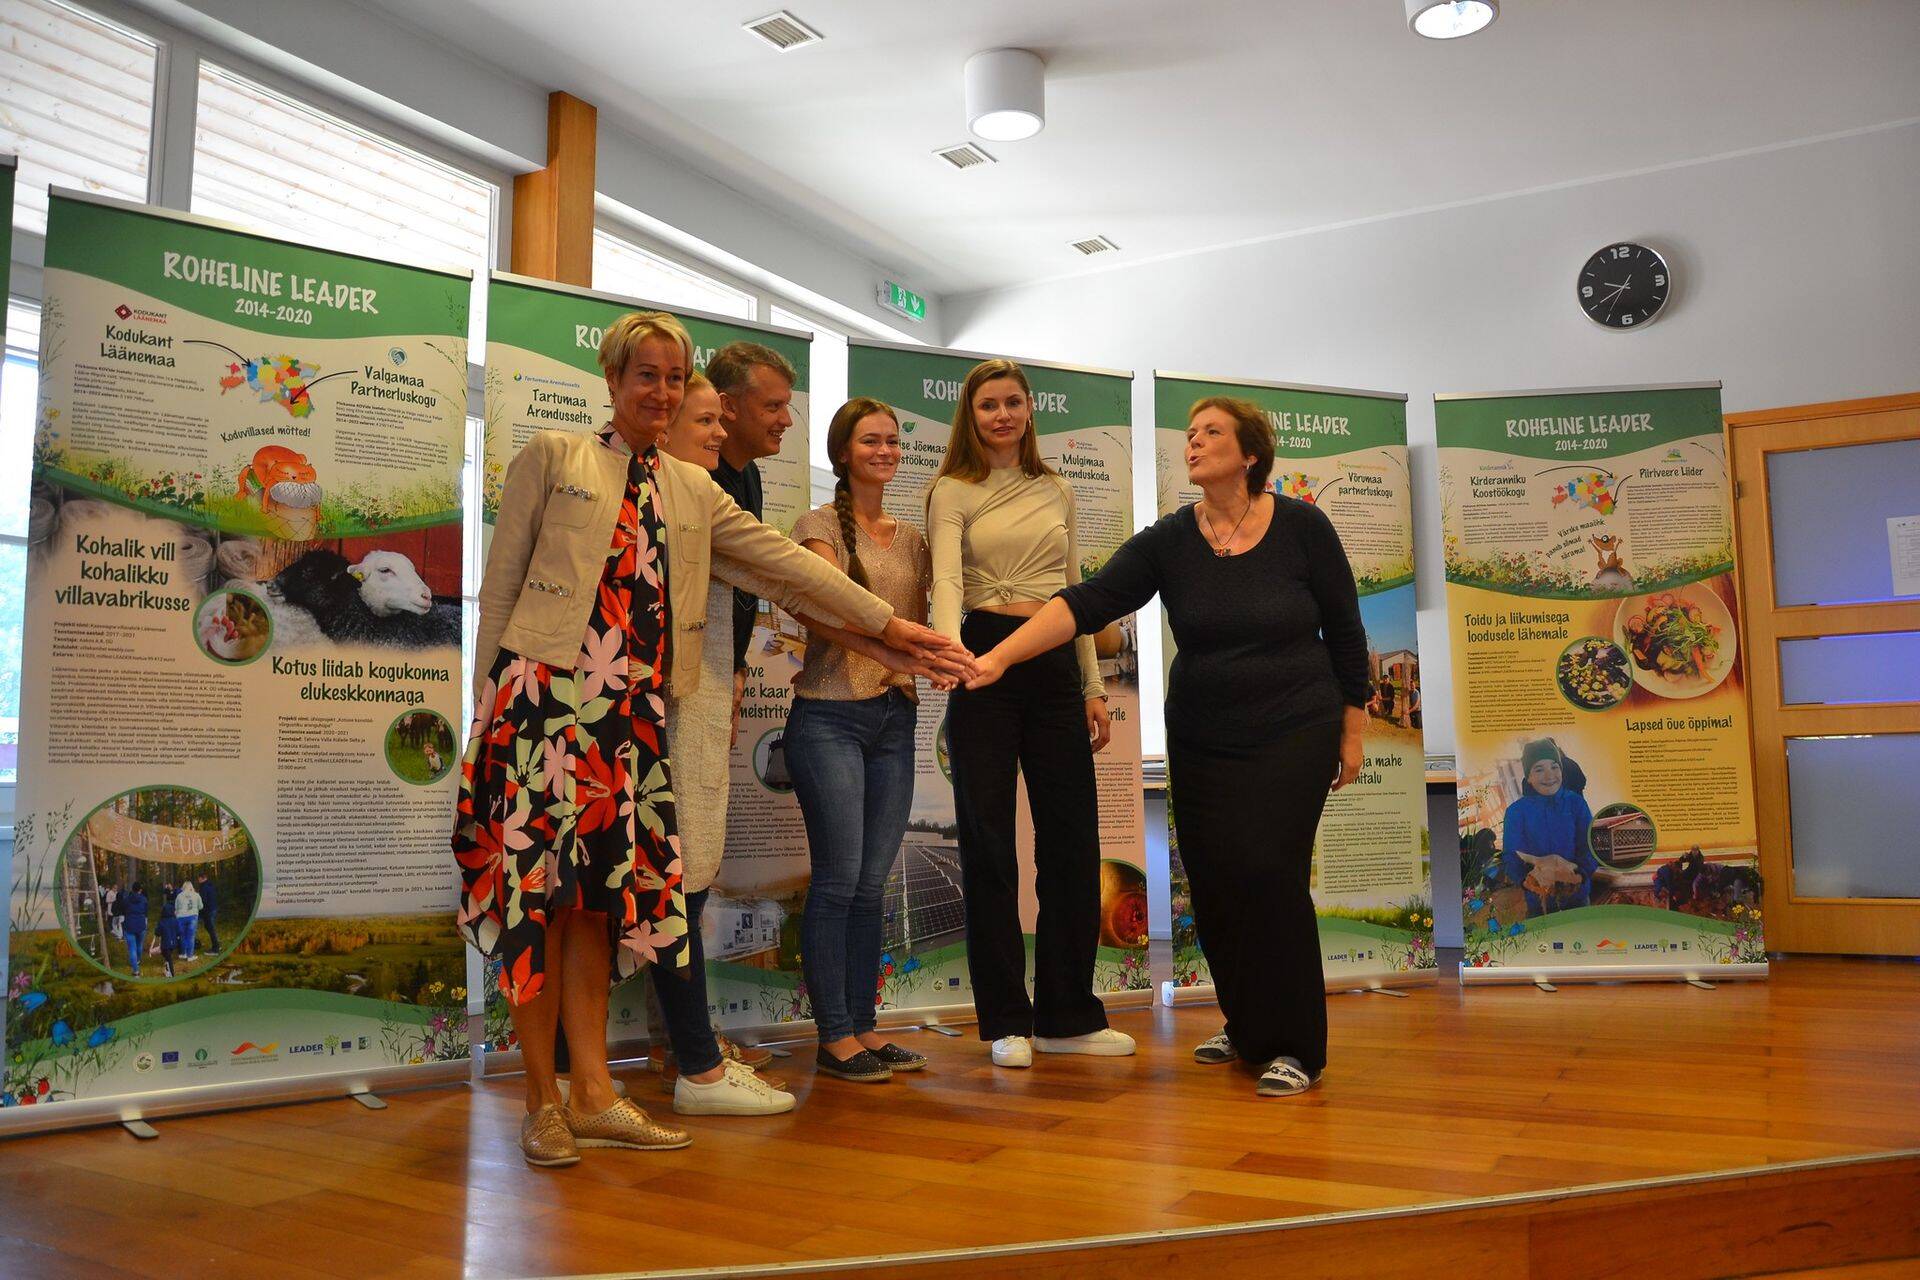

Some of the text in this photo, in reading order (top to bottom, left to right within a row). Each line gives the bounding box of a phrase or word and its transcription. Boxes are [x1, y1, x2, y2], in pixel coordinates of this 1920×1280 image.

[1610, 246, 1630, 260] 12
[164, 252, 379, 314] ROHELINE LEADER
[1654, 274, 1666, 287] 3
[1582, 286, 1594, 298] 9
[134, 309, 167, 318] KODUKANT
[234, 298, 312, 326] 2014-2020
[1622, 314, 1634, 325] 6
[106, 324, 174, 349] Kodukant
[101, 342, 176, 368] Läänemaa
[364, 366, 424, 388] Valgamaa
[351, 381, 437, 408] Partnerluskogu
[533, 389, 587, 407] Tartumaa
[527, 404, 592, 424] Arendusselts
[1296, 413, 1351, 436] LEADER
[1506, 413, 1654, 438] ROHELINE LEADER
[220, 425, 311, 442] Koduvillased mõtted!
[913, 440, 947, 454] Jõemaa
[1275, 436, 1312, 448] 14-2020
[1555, 438, 1608, 451] 2014-2020
[901, 454, 939, 468] stöökogu
[1062, 454, 1104, 467] Mulgimaa
[1058, 467, 1110, 481] Arenduskoda
[1348, 472, 1382, 484] Võrumaa
[1470, 474, 1526, 486] Kirderanniku
[1640, 467, 1704, 478] Piiriveere Liider
[1338, 486, 1393, 499] partnerluskogu
[1472, 488, 1526, 498] Koostöökogu
[76, 534, 176, 562] Kohalik vill
[81, 560, 169, 586] kohalikku
[55, 587, 190, 612] villavabrikusse
[1464, 611, 1570, 627] Toidu ja liikumisega
[1467, 627, 1568, 643] loodusele lähemale
[272, 656, 450, 683] Kotus liidab kogukonna
[300, 682, 425, 705] elukeskkonnaga
[760, 683, 790, 698] kaar
[1626, 718, 1664, 733] Lapsed
[1688, 715, 1733, 731] õppima!
[1375, 754, 1402, 766] mahe
[128, 826, 174, 853] UMA
[290, 1044, 323, 1054] LEADER
